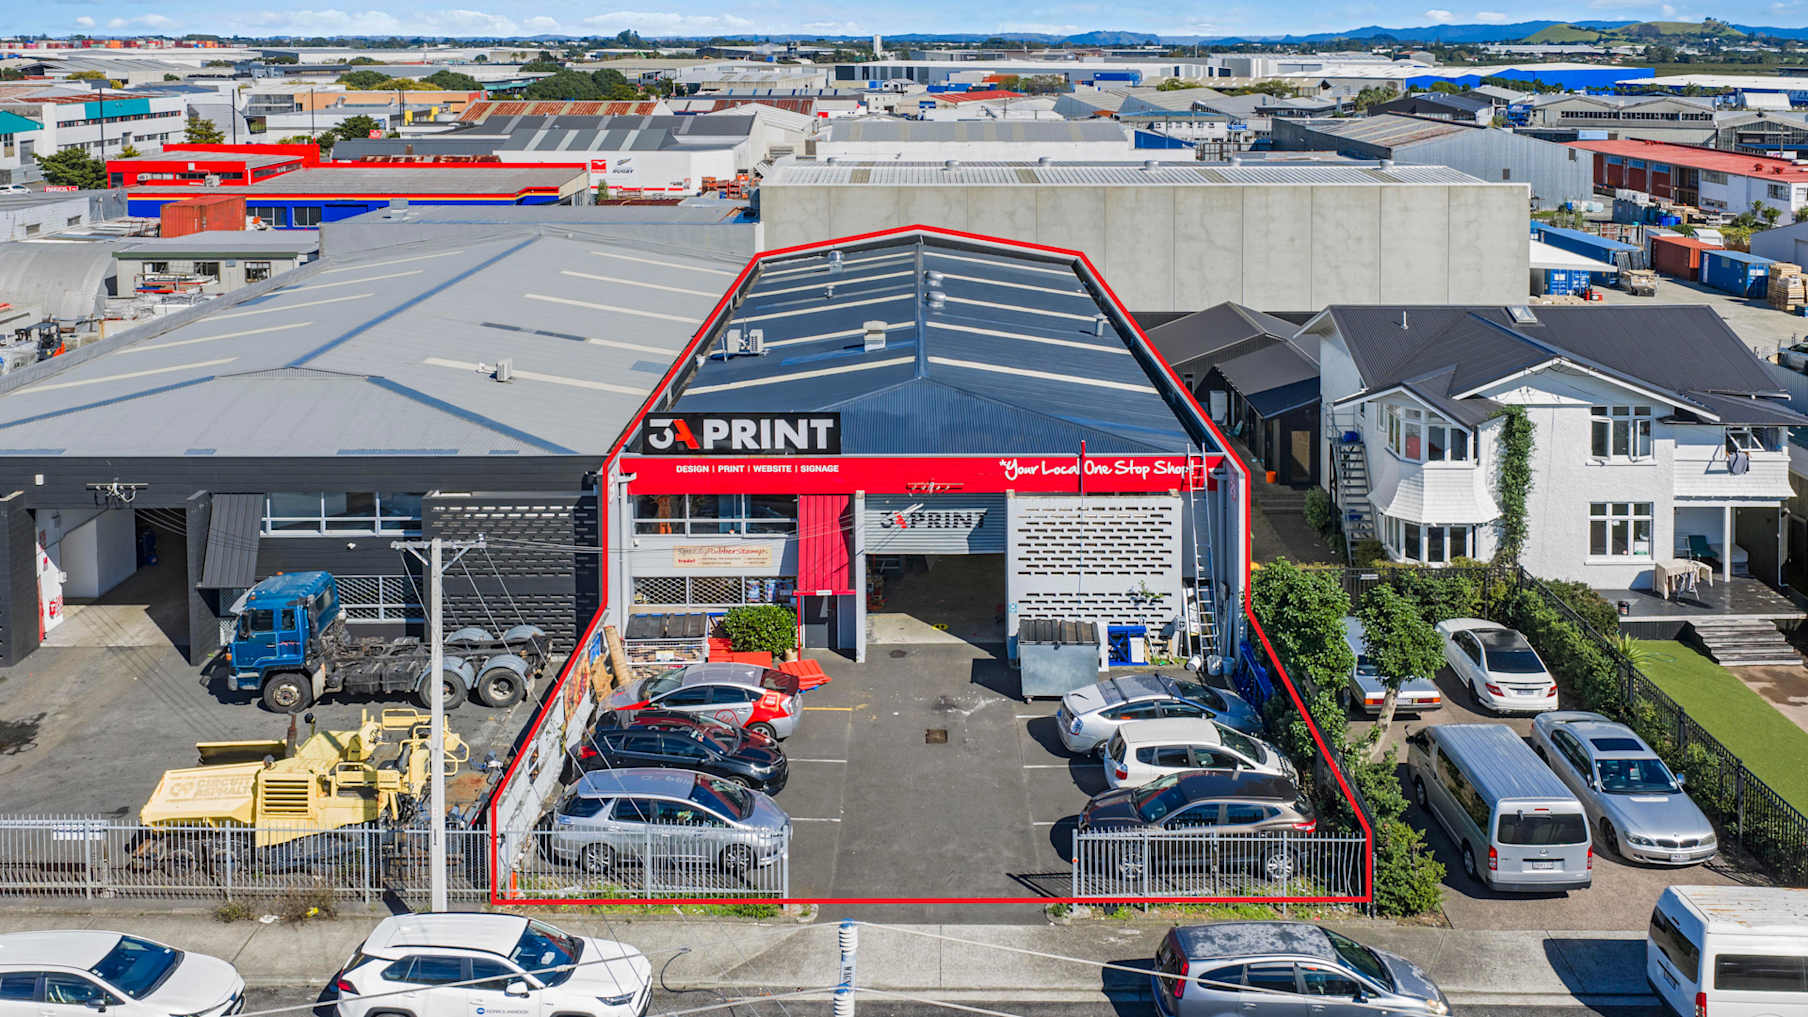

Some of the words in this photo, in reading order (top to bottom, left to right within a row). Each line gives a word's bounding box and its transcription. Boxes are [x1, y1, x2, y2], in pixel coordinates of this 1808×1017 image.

[703, 418, 834, 450] PRINT
[676, 464, 709, 473] DESIGN
[717, 464, 745, 473] PRINT
[753, 464, 792, 473] WEBSITE
[800, 464, 839, 473] SIGNAGE
[1041, 457, 1080, 475] Local
[1085, 460, 1112, 475] One
[1114, 460, 1151, 480] Stop
[910, 511, 988, 528] PRINT
